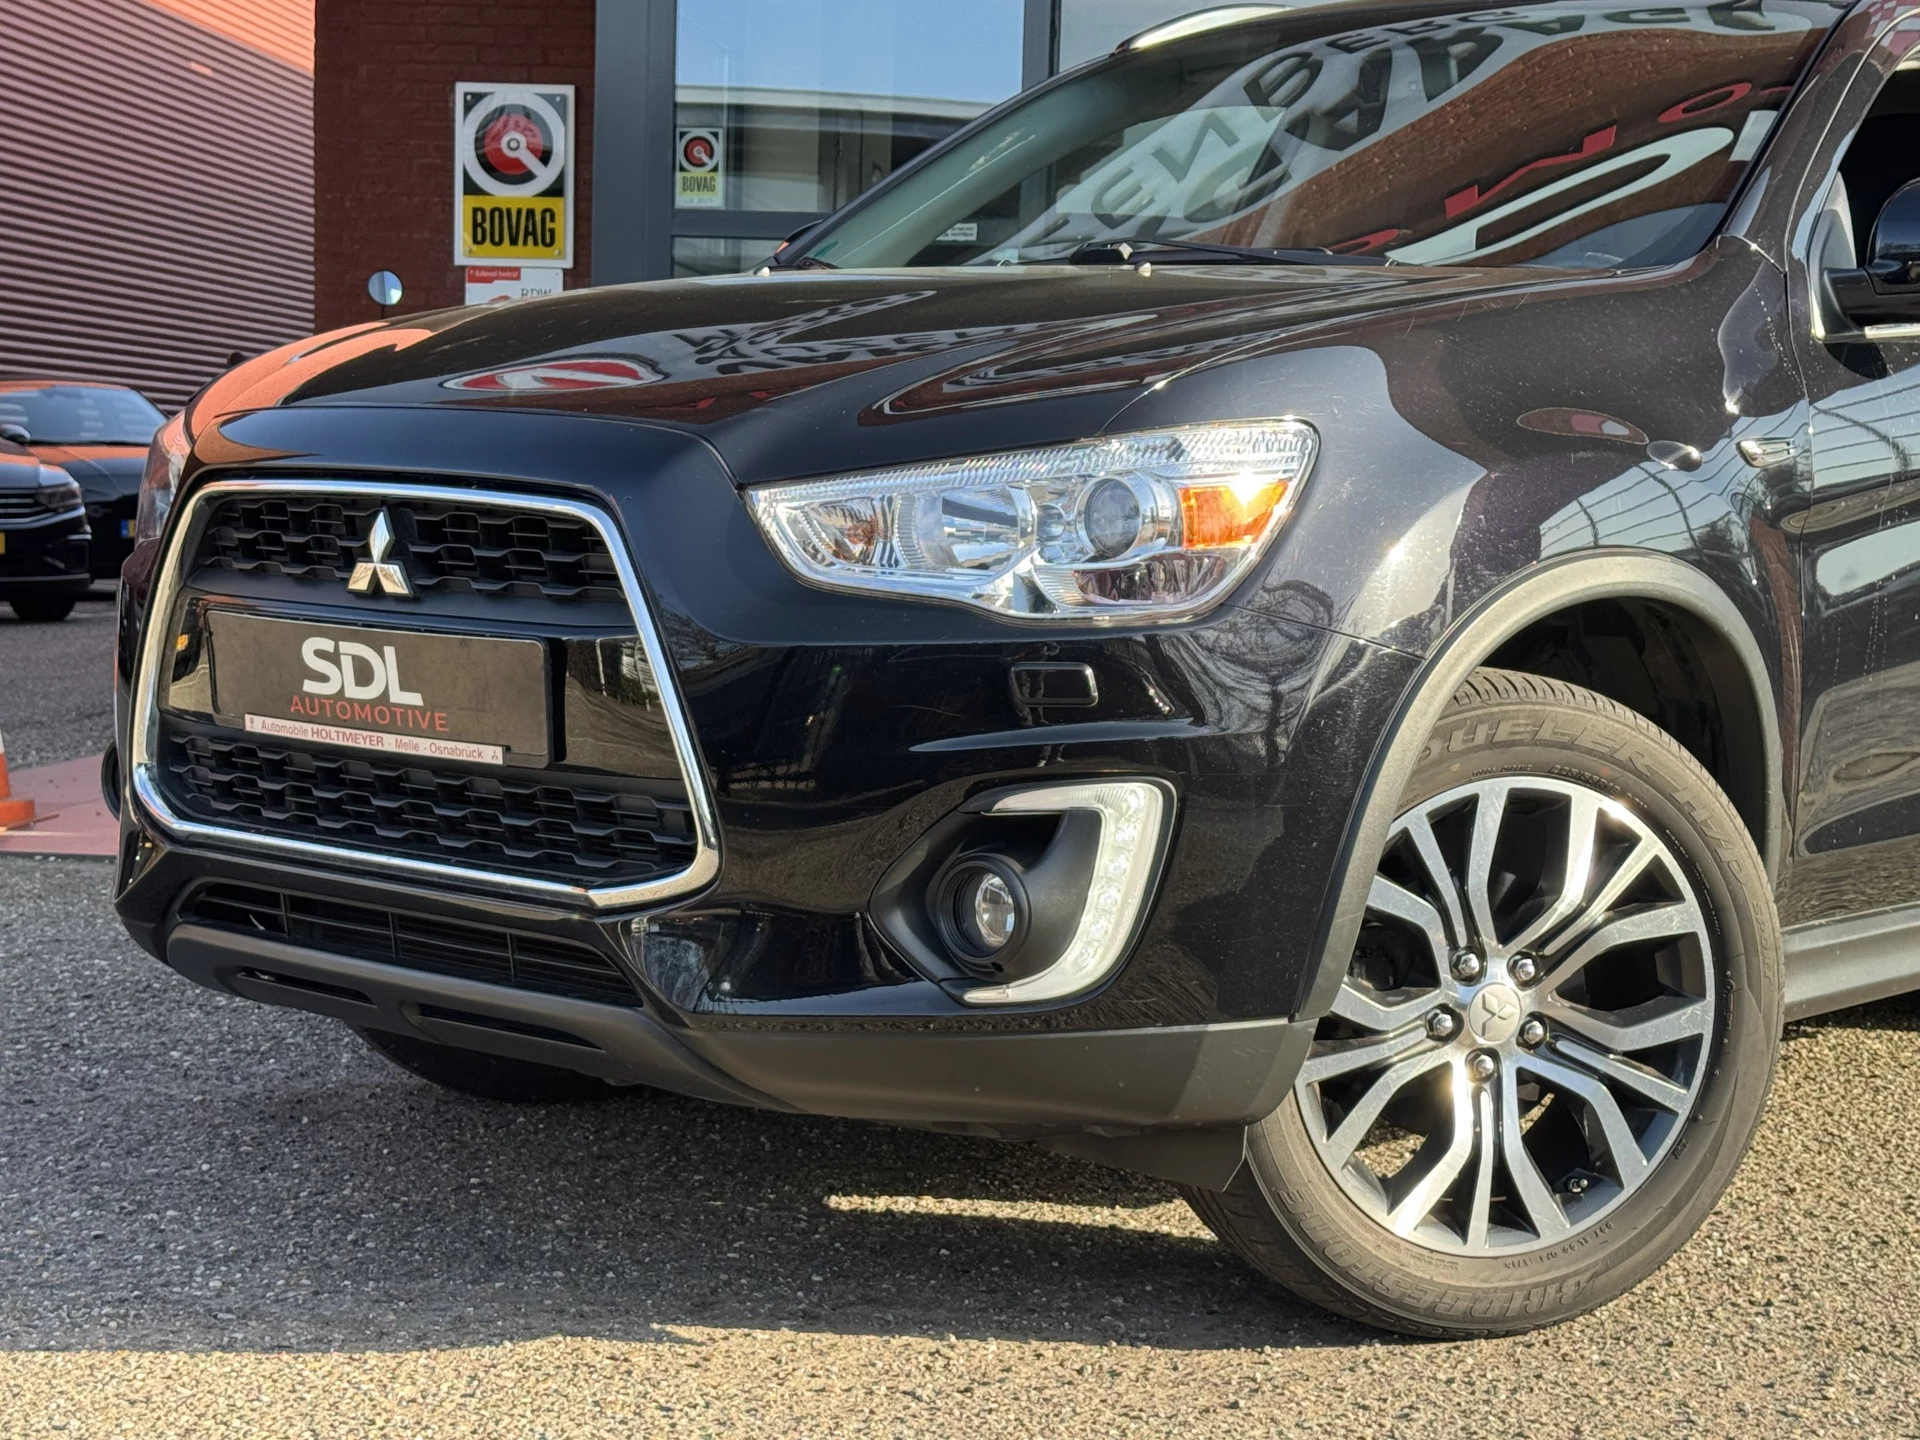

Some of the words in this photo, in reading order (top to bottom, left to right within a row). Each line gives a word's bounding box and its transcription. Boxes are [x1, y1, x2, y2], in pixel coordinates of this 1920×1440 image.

[682, 176, 716, 192] BOVAG
[472, 206, 556, 248] BOVAG
[301, 636, 424, 706] SDL
[290, 695, 449, 732] AUTOMOTIVE
[261, 720, 309, 738] Automobile
[310, 727, 384, 748] HOLTMEYER
[429, 742, 483, 760] Osnabrück
[1276, 1187, 1600, 1319] BRIDGESTONE
